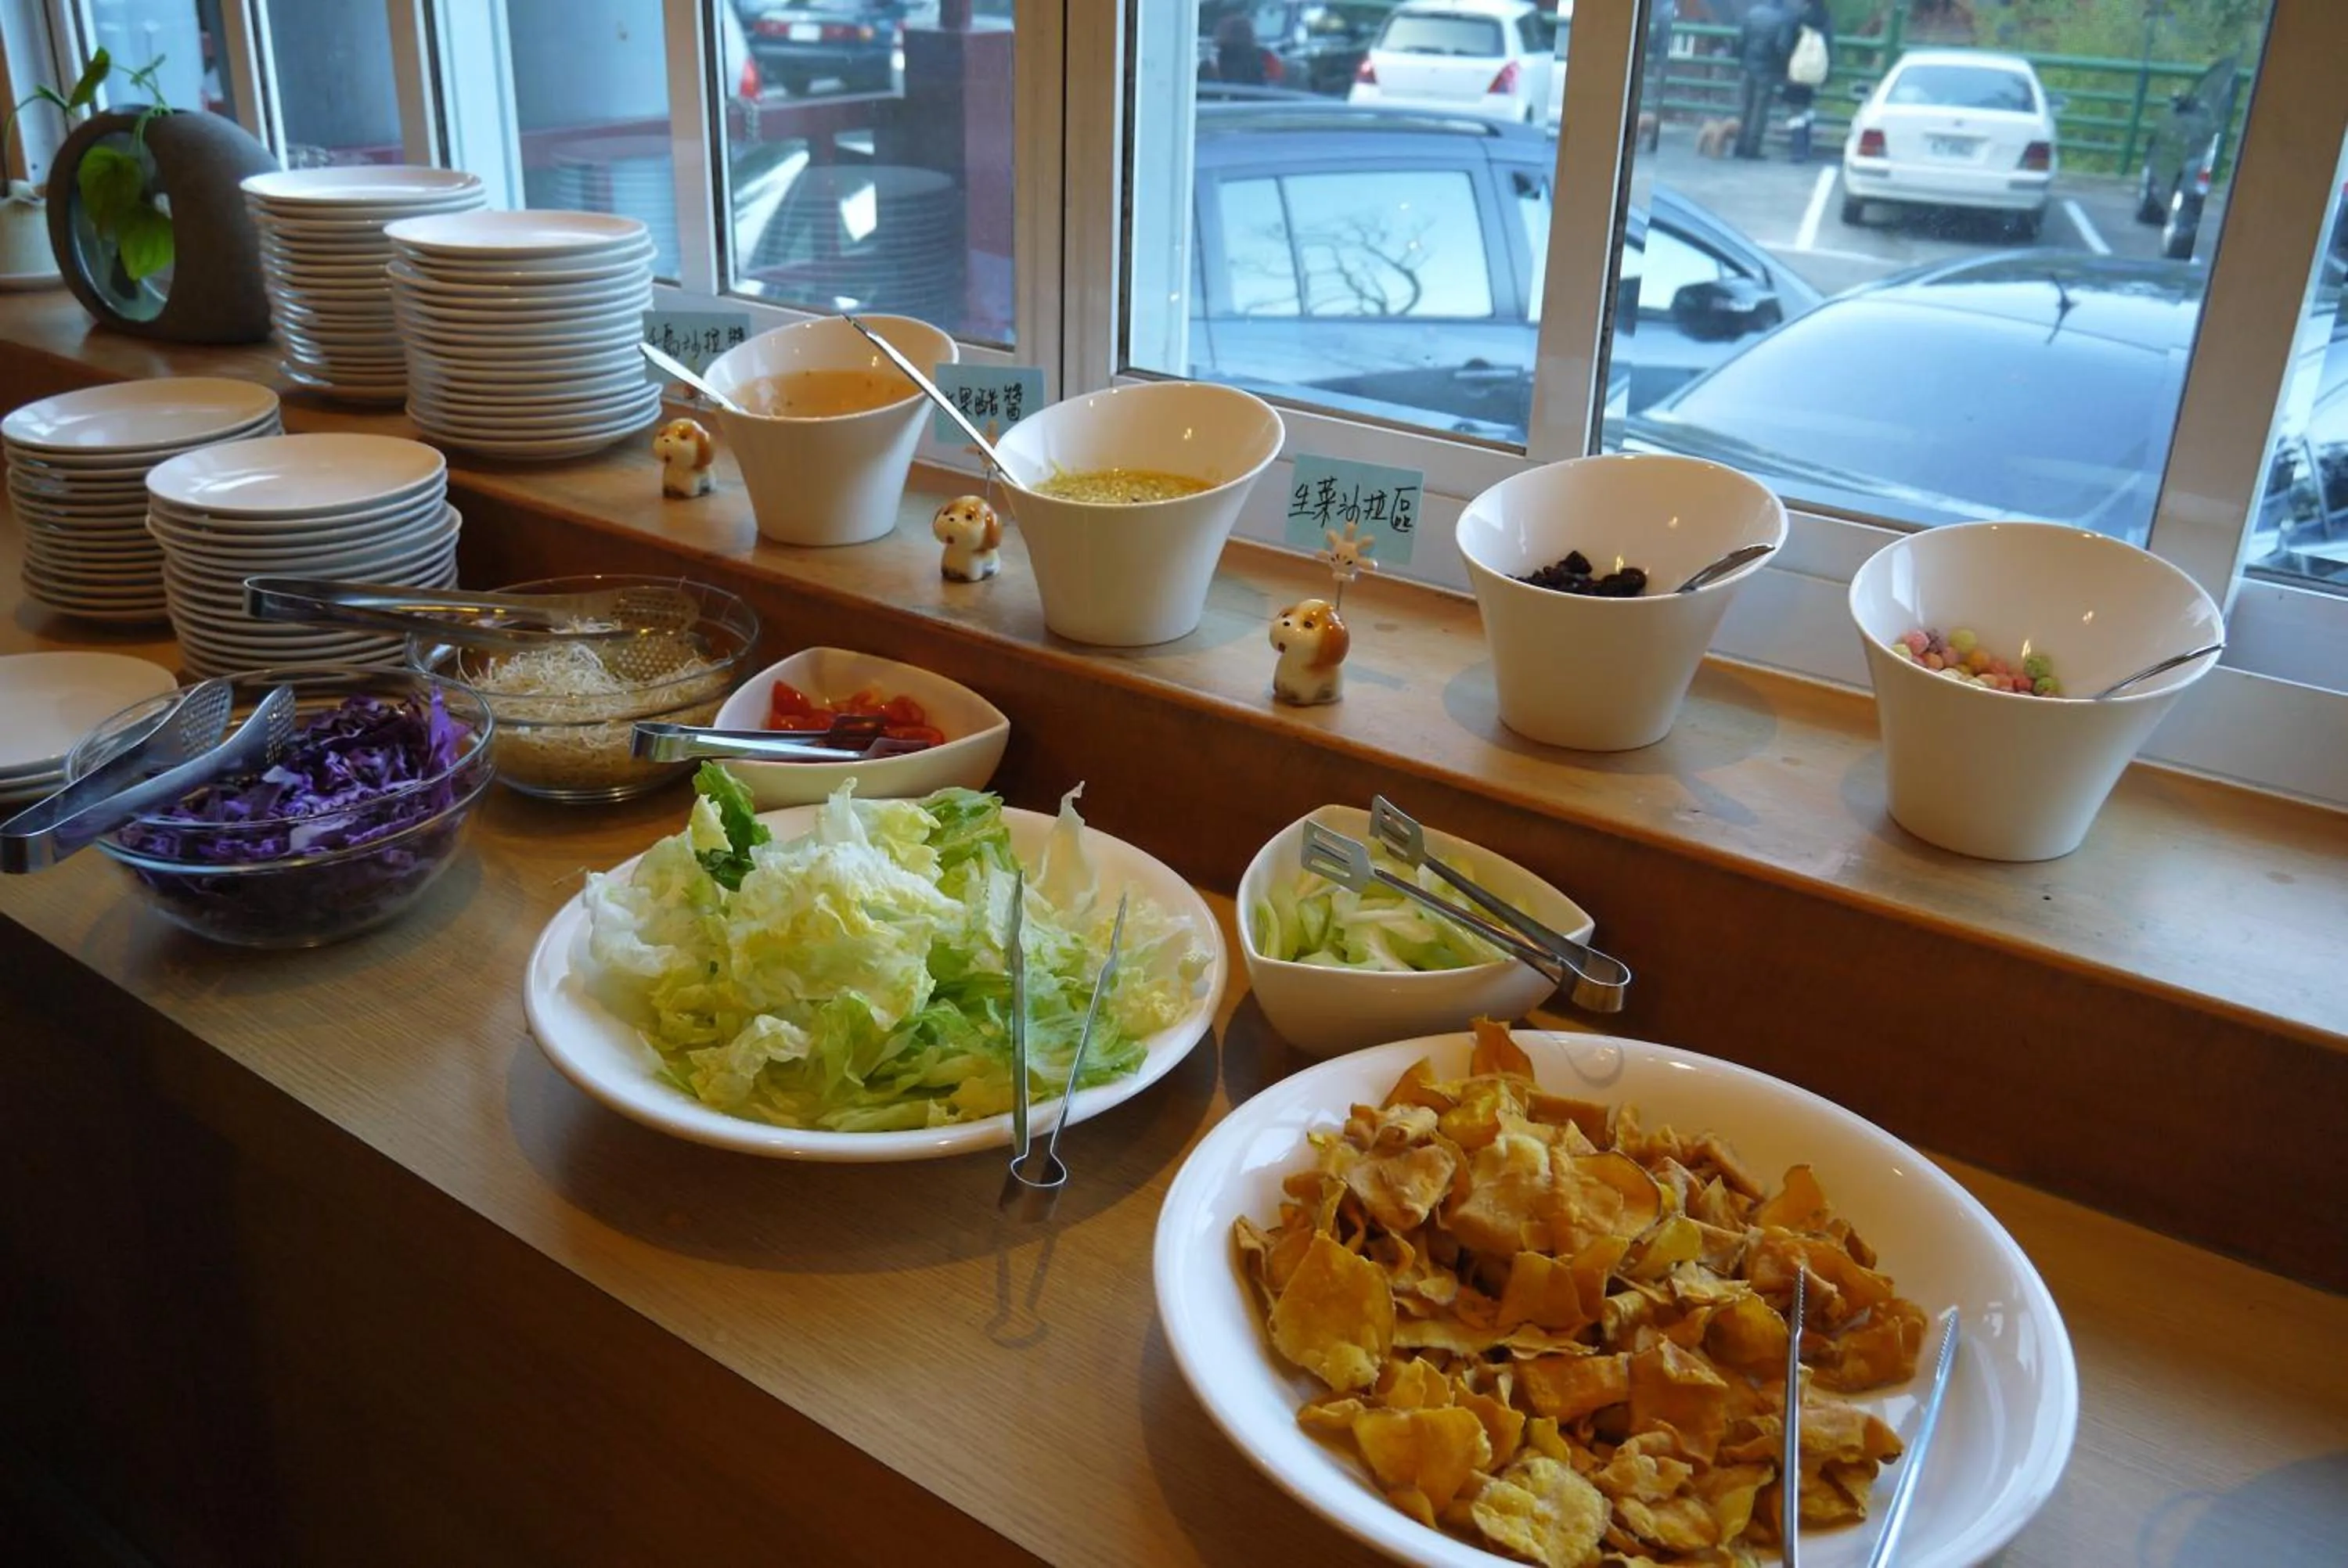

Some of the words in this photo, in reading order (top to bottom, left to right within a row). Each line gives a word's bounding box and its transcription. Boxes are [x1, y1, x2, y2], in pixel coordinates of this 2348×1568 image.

[1288, 476, 1417, 532] 生菜沙拉區
